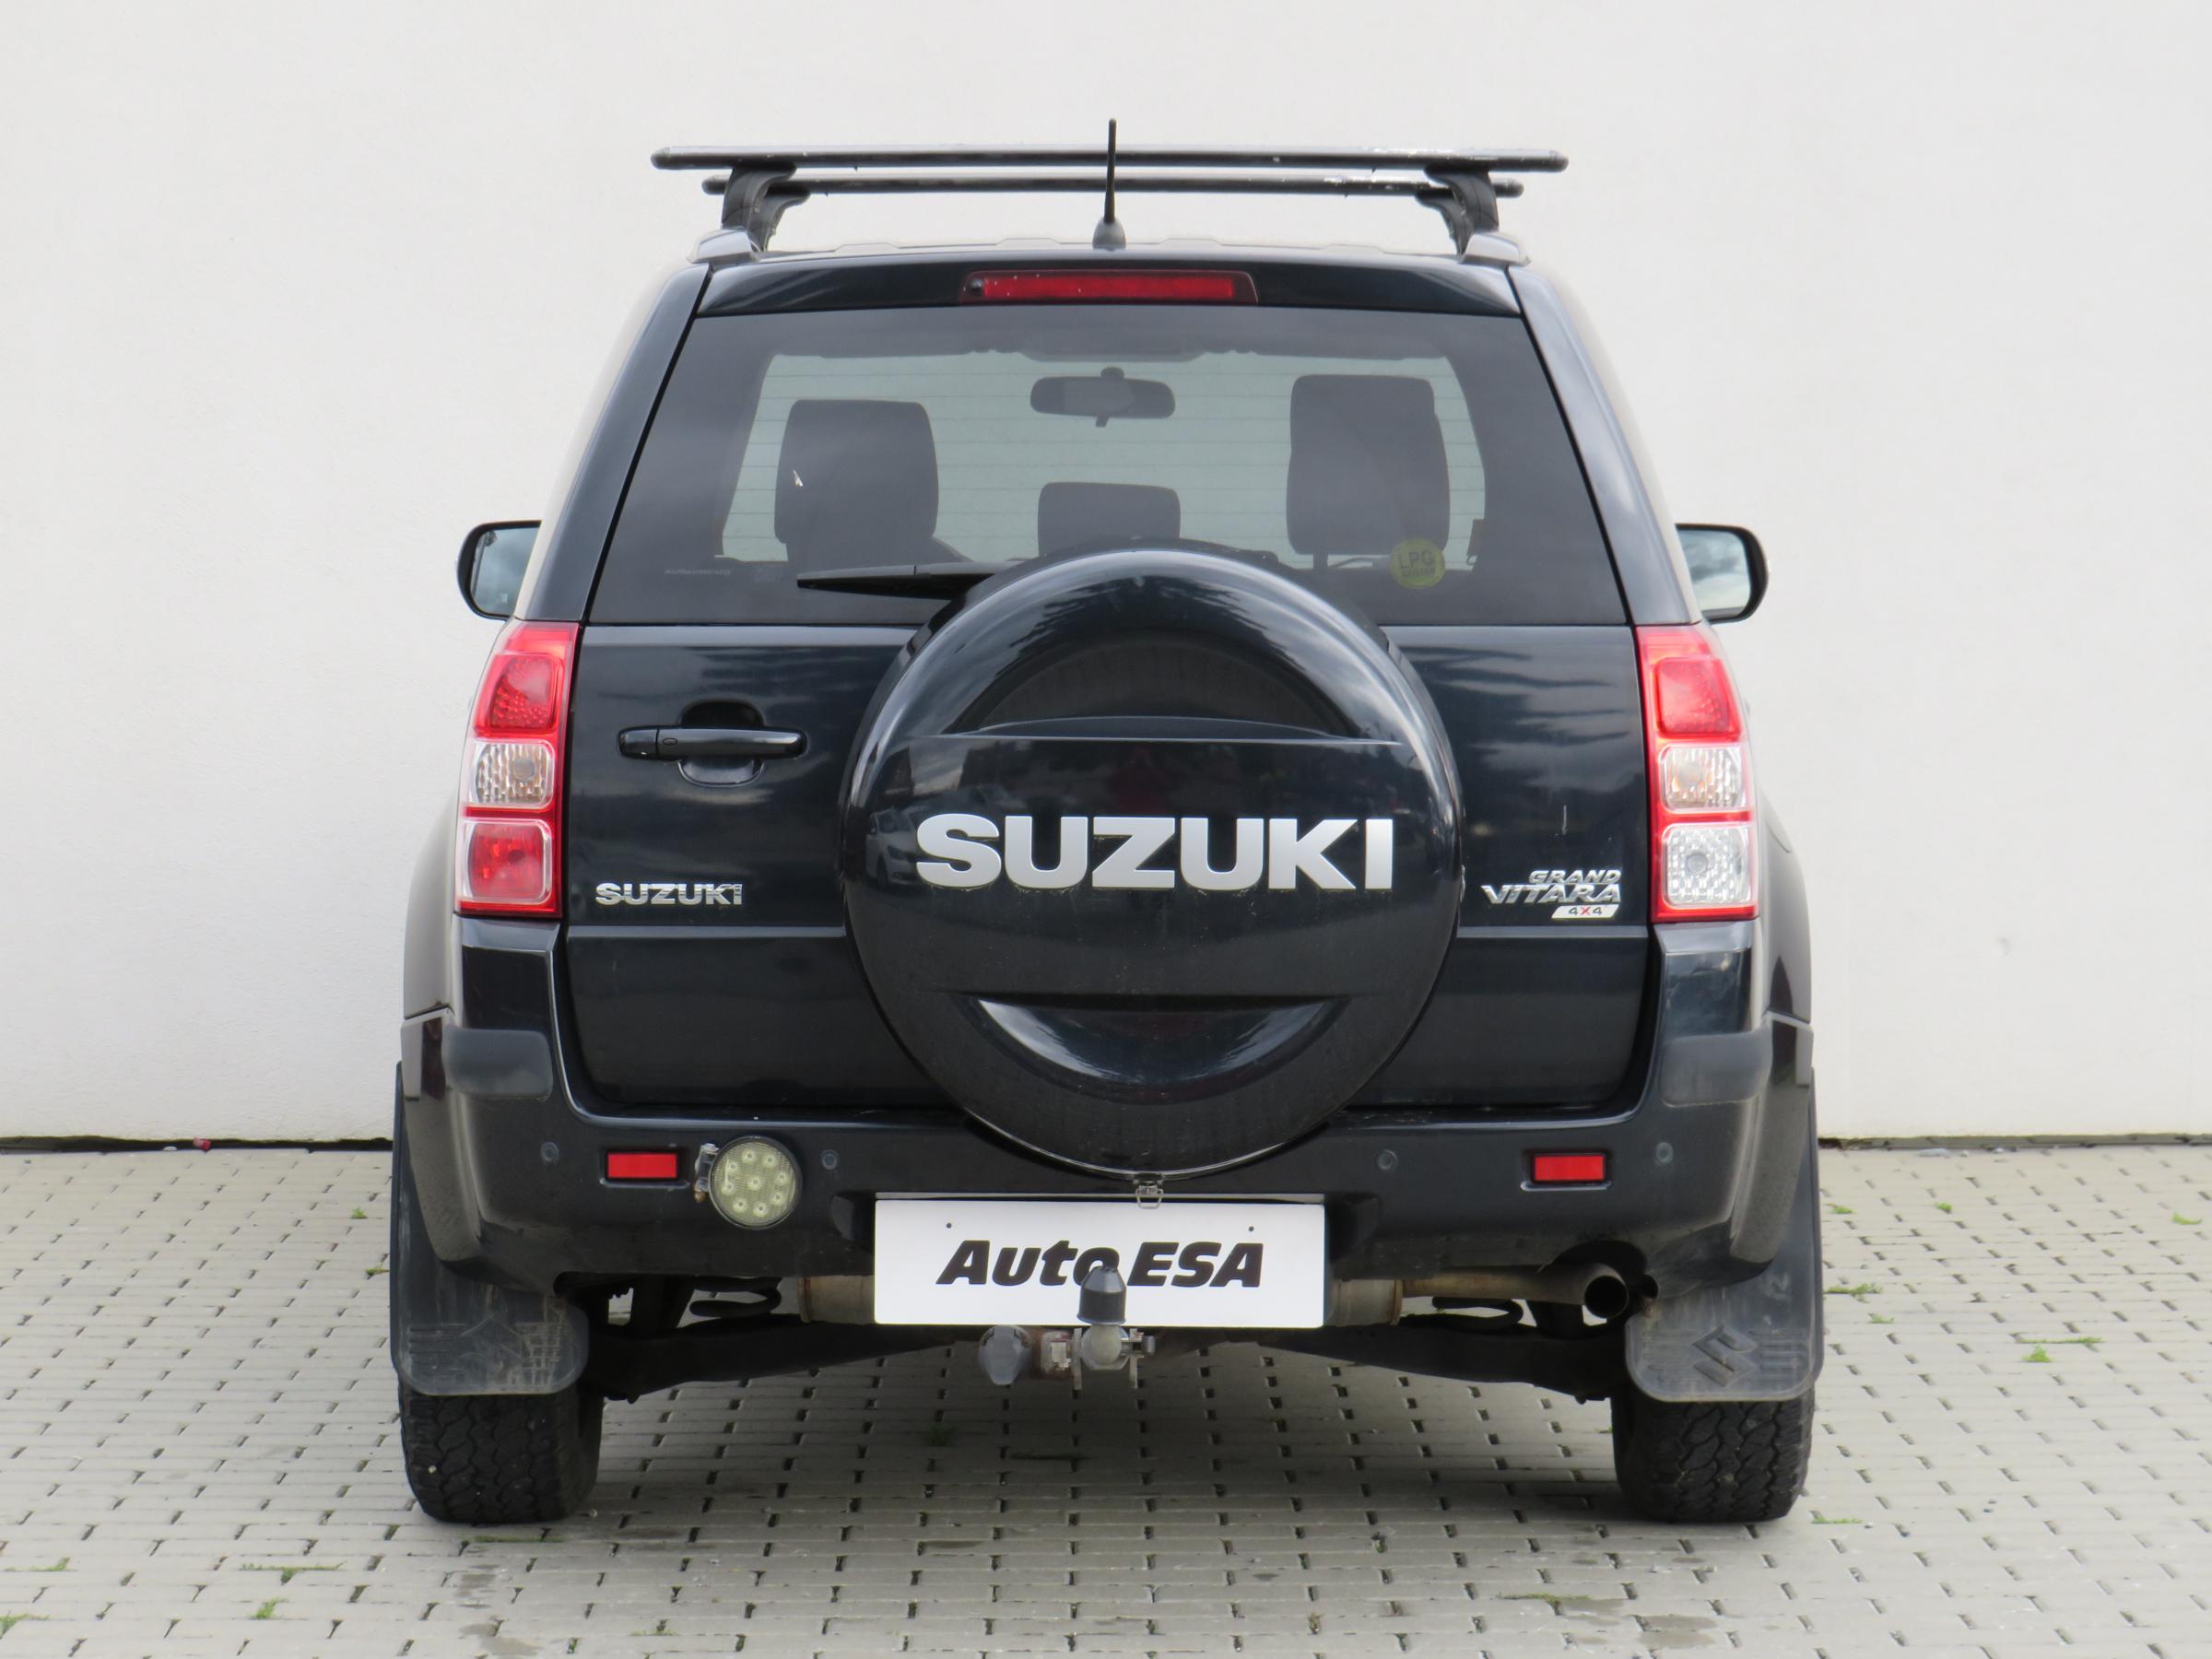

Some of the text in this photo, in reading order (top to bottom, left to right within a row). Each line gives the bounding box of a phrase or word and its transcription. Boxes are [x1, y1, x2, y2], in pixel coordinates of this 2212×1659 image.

[1397, 549, 1436, 570] LPG
[916, 813, 1394, 890] SUZUKI
[1529, 869, 1622, 884] GRAND
[595, 882, 743, 905] SUZUKI
[1480, 883, 1622, 904] VITARA
[935, 1241, 1264, 1288] Auto ESA
